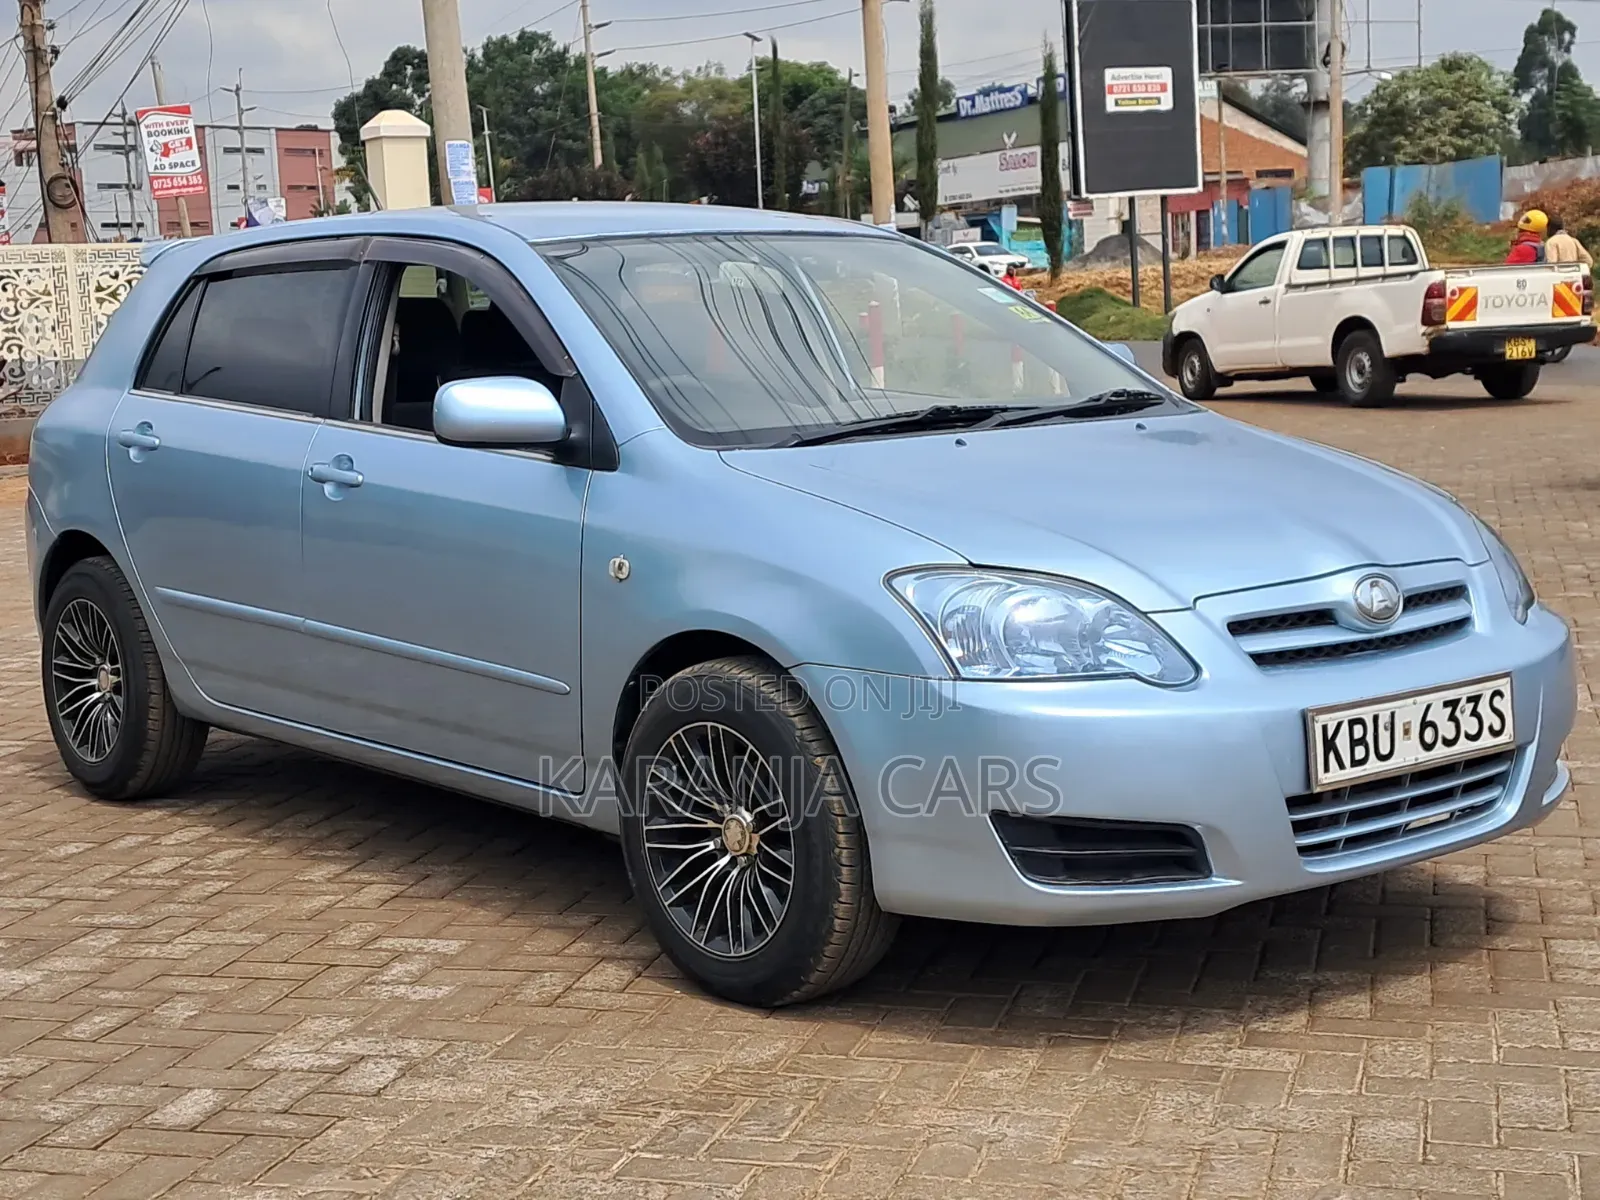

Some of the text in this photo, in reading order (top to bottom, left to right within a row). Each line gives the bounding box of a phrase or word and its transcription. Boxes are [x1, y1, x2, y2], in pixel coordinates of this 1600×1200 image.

[144, 119, 190, 130] WITH EVERY
[146, 126, 190, 138] BOOKING
[168, 139, 187, 149] GET
[153, 160, 197, 171] AD SPACE
[152, 177, 172, 189] 0725
[172, 175, 188, 187] 654
[1482, 292, 1548, 309] TOYOTA
[1508, 347, 1534, 358] 216V
[1321, 689, 1507, 774] KBU 633S
